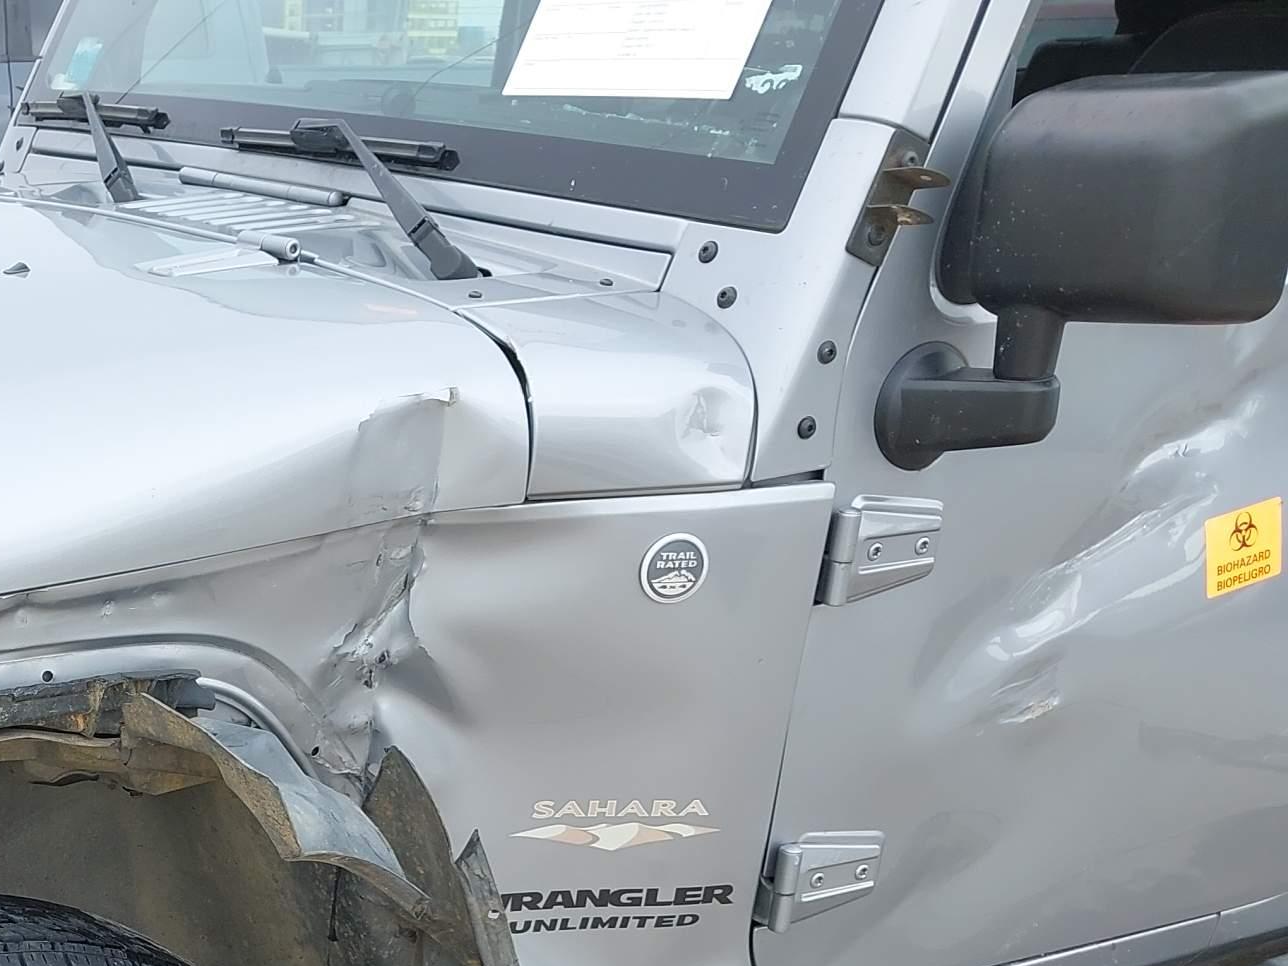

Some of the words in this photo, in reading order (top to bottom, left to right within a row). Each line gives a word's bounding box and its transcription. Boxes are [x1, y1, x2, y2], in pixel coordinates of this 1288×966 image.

[656, 560, 698, 569] RATED
[660, 551, 697, 560] TRAIL
[1216, 549, 1271, 576] BIOHAZARD
[1216, 564, 1271, 591] BIOPELIGRO
[531, 799, 710, 819] SAHARA
[510, 913, 700, 934] UNLIMITED
